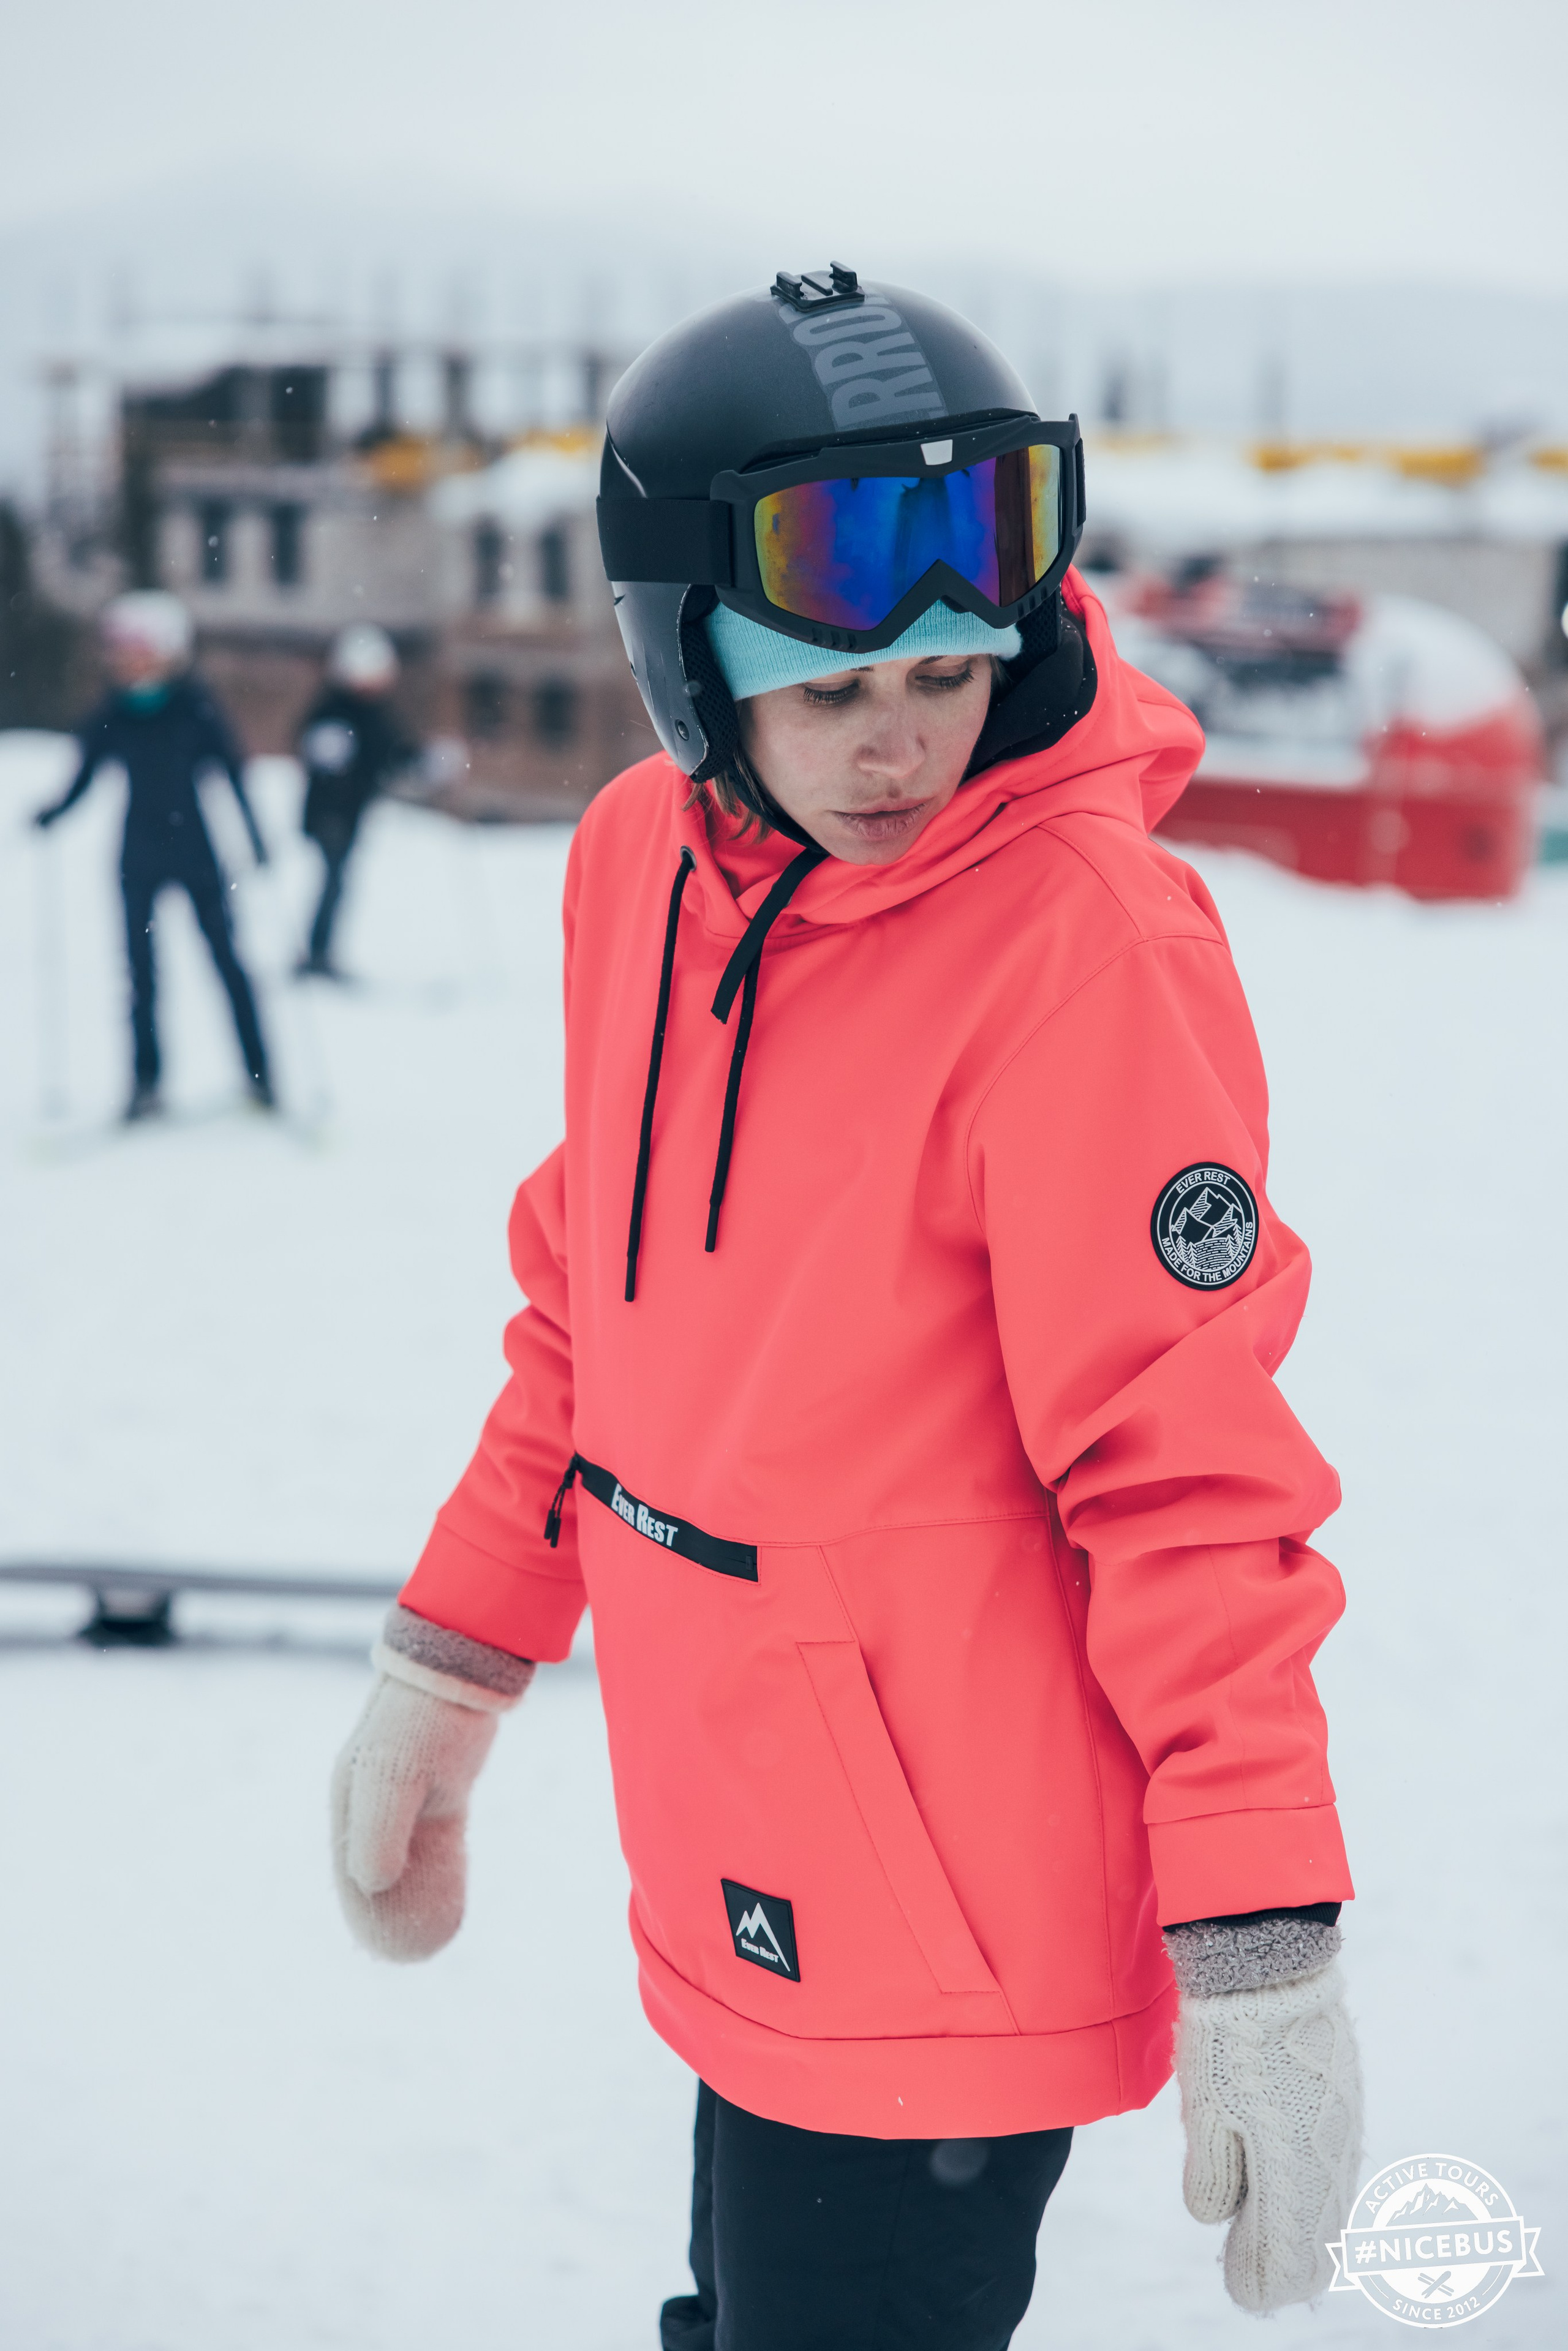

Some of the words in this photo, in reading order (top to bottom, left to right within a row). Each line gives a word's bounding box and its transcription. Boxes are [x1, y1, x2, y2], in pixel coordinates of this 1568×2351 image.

[1175, 1172, 1202, 1194] EVER
[1204, 1171, 1231, 1185] REST
[1161, 1237, 1182, 1268] MADE
[1180, 1263, 1201, 1281] FOR
[1202, 1272, 1223, 1282] THE
[1223, 1221, 1253, 1278] MOUNTAINS
[611, 1482, 635, 1526] EVER
[636, 1503, 679, 1547] REST
